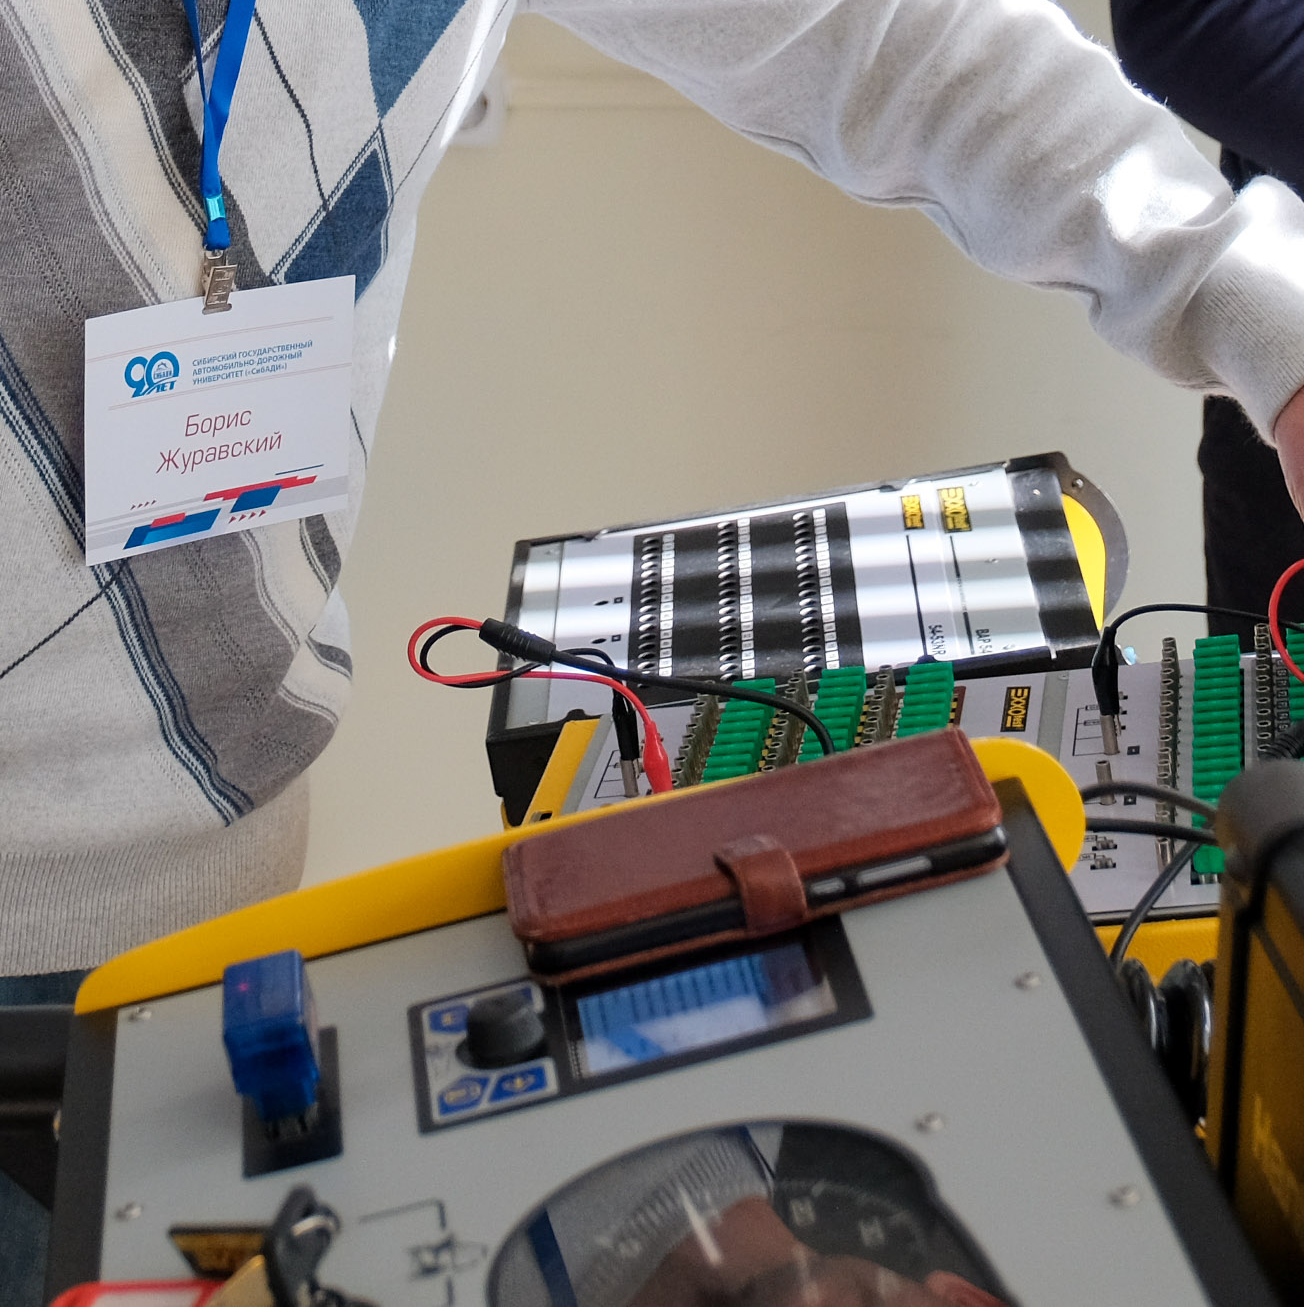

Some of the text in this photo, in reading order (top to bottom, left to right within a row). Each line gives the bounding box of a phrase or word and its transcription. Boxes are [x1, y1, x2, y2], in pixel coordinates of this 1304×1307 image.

[192, 339, 313, 367] СИБИРСКИЙ ГОСУДАРСТВЕННЫЙ
[124, 351, 180, 398] 90
[192, 370, 244, 386] УНИВЕРСИТЕТ
[184, 408, 252, 438] Борис
[155, 431, 283, 475] Журавский
